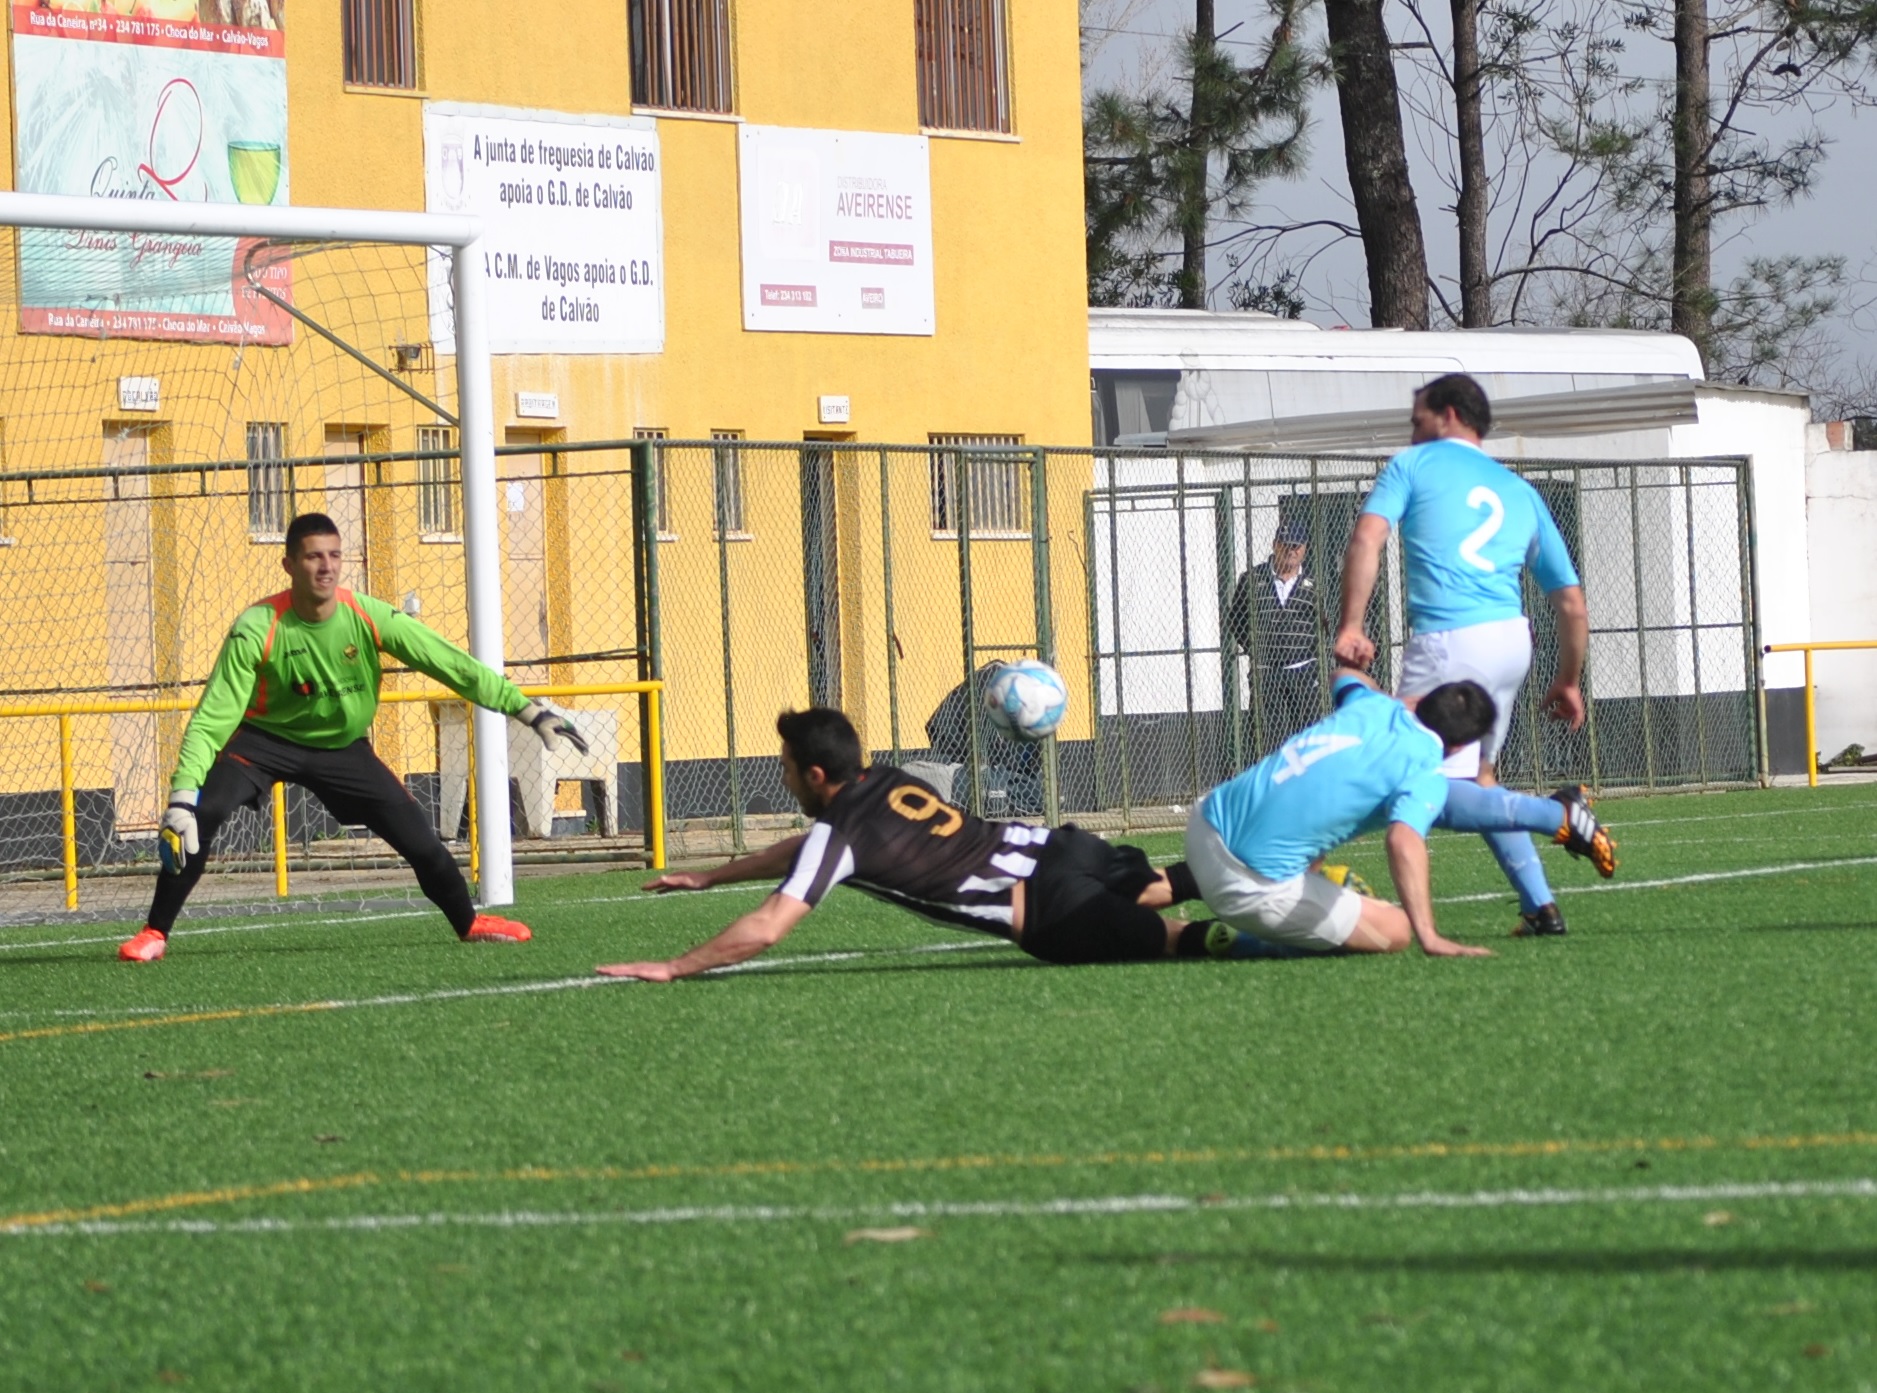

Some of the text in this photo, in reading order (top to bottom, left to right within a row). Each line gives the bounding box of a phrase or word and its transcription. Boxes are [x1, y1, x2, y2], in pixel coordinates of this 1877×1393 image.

[30, 11, 45, 26] Rua
[46, 12, 57, 27] da
[116, 19, 130, 34] 234
[131, 20, 145, 35] 781
[147, 22, 160, 37] 175
[165, 24, 188, 39] Choca
[188, 25, 199, 40] do
[200, 27, 214, 42] Mar
[473, 134, 655, 172] A junta de freguesia de Calvão
[500, 178, 533, 209] apoia
[537, 186, 544, 206] o
[547, 179, 572, 207] G.D.
[575, 182, 590, 208] de
[593, 182, 633, 210] Calvão
[836, 192, 913, 220] AVEIRENSE
[494, 252, 522, 280] C.M.
[526, 254, 541, 280] de
[544, 255, 580, 288] Vagos
[583, 258, 616, 288] apoia
[619, 265, 627, 285] o
[630, 260, 654, 286] G.D.
[65, 313, 75, 328] da
[163, 317, 185, 332] Choca
[186, 318, 196, 332] do
[196, 319, 210, 333] Mar
[541, 295, 600, 322] de Calvão
[1458, 485, 1504, 571] 2
[888, 784, 963, 837] 9
